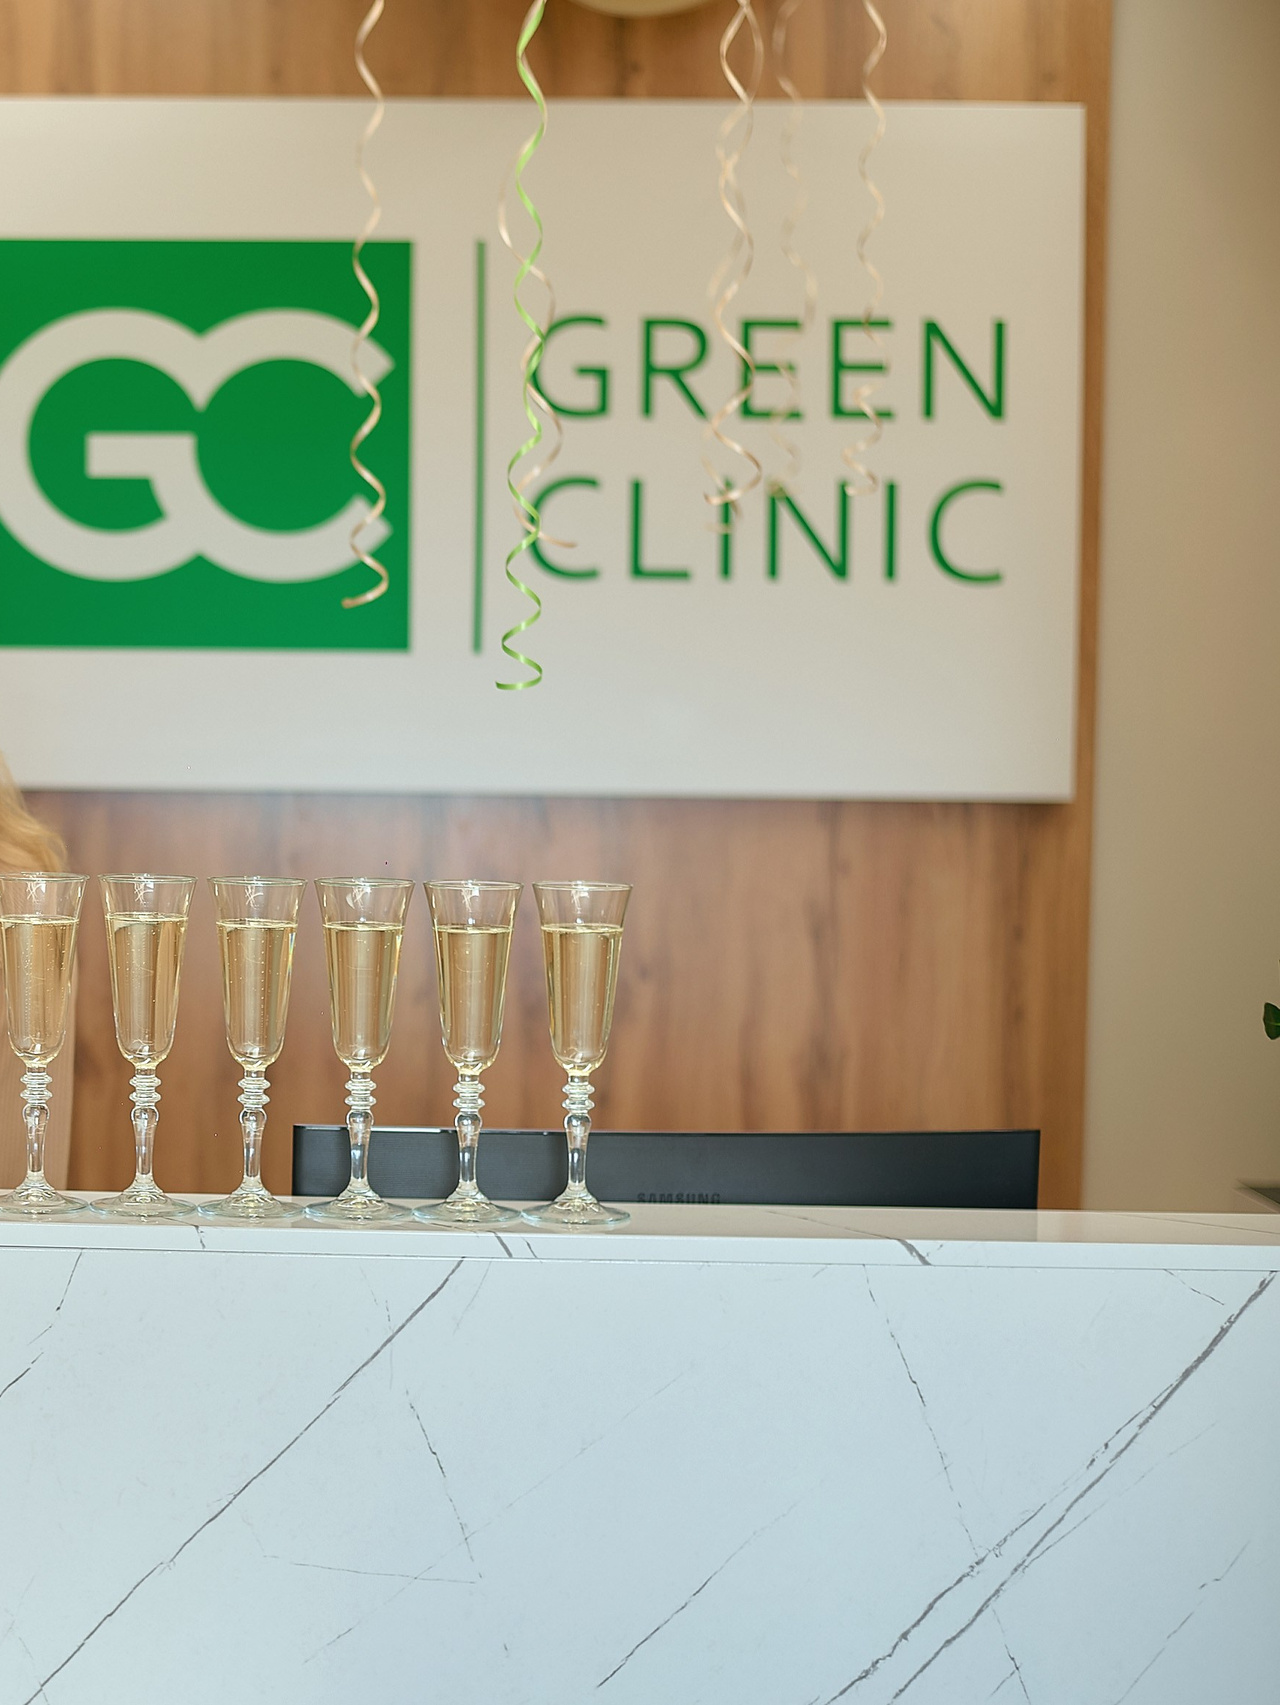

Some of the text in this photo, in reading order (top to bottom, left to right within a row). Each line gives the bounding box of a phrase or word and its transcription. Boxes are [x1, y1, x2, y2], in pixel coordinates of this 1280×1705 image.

[530, 313, 1007, 423] GREEN
[524, 475, 1005, 585] CLINIC
[637, 1193, 721, 1204] SAMSUNG
